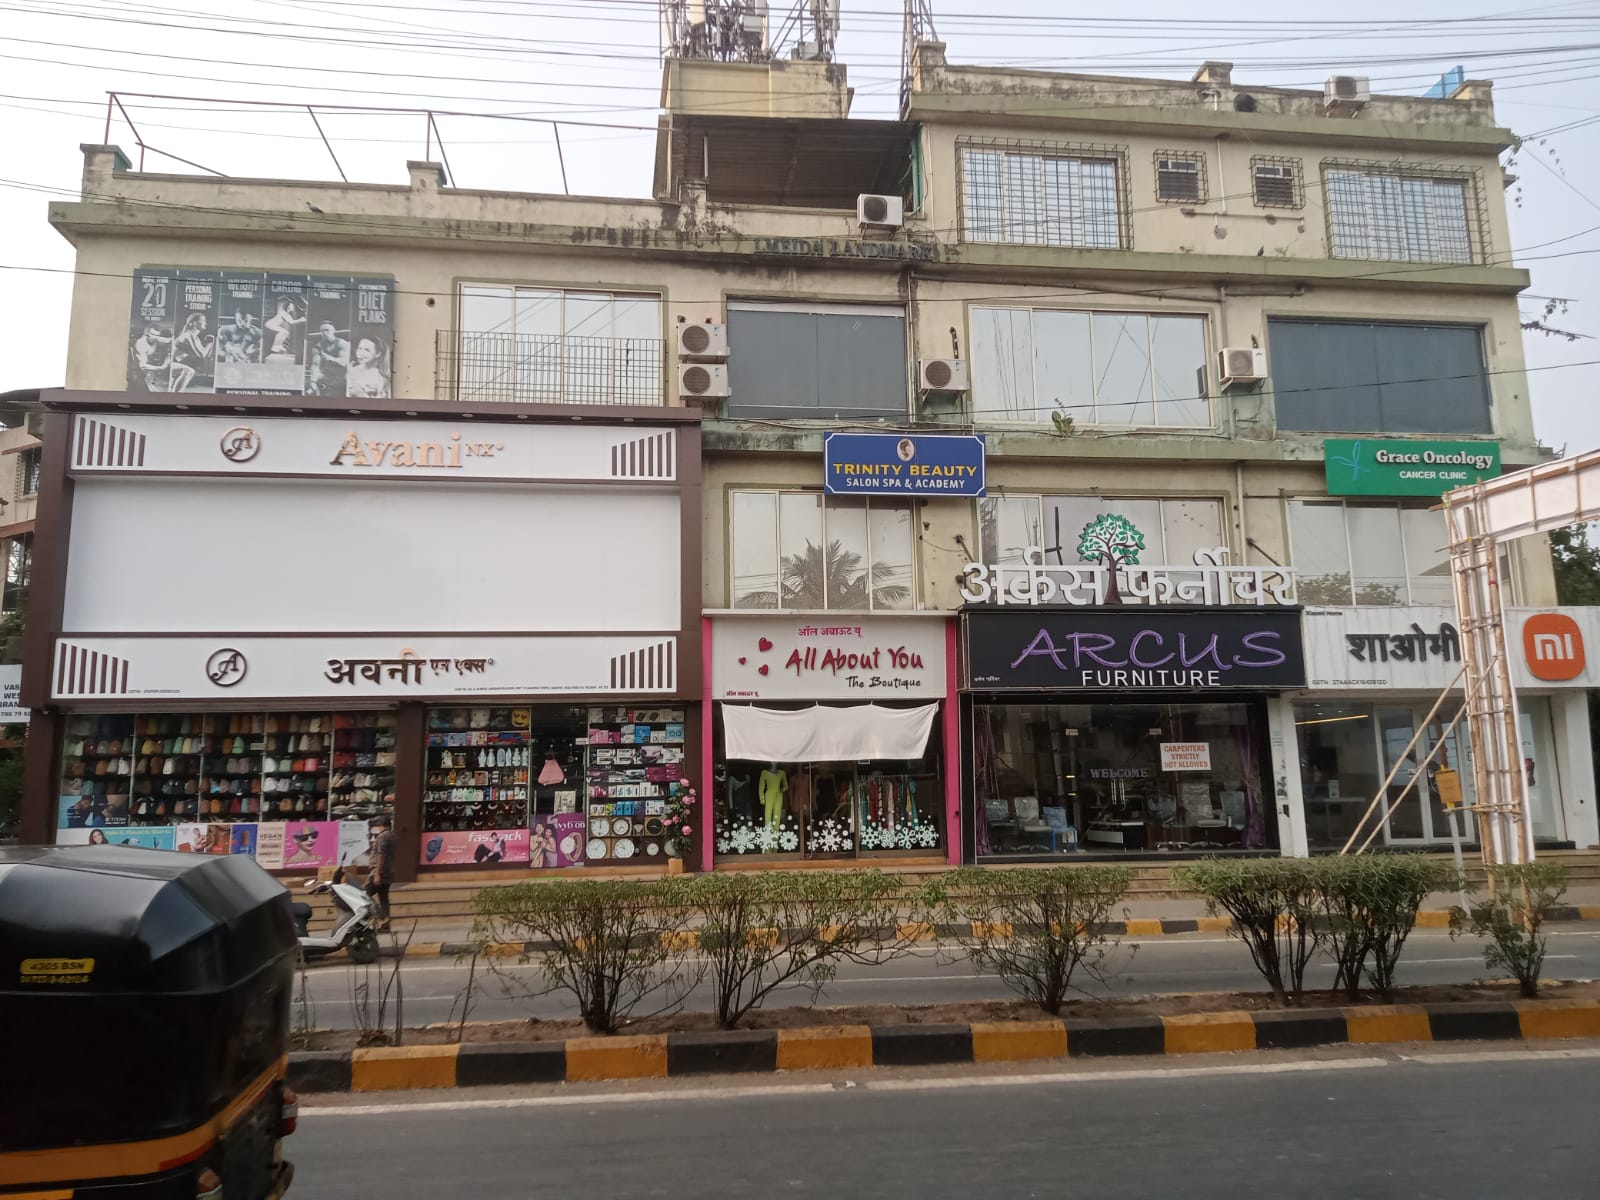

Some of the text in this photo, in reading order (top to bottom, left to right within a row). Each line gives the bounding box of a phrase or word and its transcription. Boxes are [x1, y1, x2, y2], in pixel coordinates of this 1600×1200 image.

[830, 240, 935, 261] LANDMARK
[185, 285, 212, 294] PERSONAL
[228, 279, 258, 291] WEIGHT
[271, 280, 302, 293] CARDIO
[142, 283, 166, 308] 20
[185, 294, 212, 303] TRAINING
[358, 291, 386, 310] DIET
[358, 310, 387, 323] PLANS
[329, 431, 464, 468] Avani
[1375, 449, 1494, 469] Grace Oncology
[833, 463, 977, 477] TRINITY BEAUTY
[1399, 471, 1468, 480] CANCER CLINIC
[846, 477, 966, 489] SALON SPA & ACADEMY
[798, 625, 818, 636] ऑल
[1010, 628, 1287, 671] ARCUS
[1345, 622, 1461, 663] शाओमी
[324, 648, 426, 685] अवनी
[785, 645, 924, 677] All About You
[845, 675, 922, 689] The Boutique
[1082, 670, 1221, 687] FURNITURE
[1164, 745, 1206, 753] CARPENTERS
[1178, 760, 1208, 768] ALLOWED
[1090, 768, 1148, 778] WELCOME
